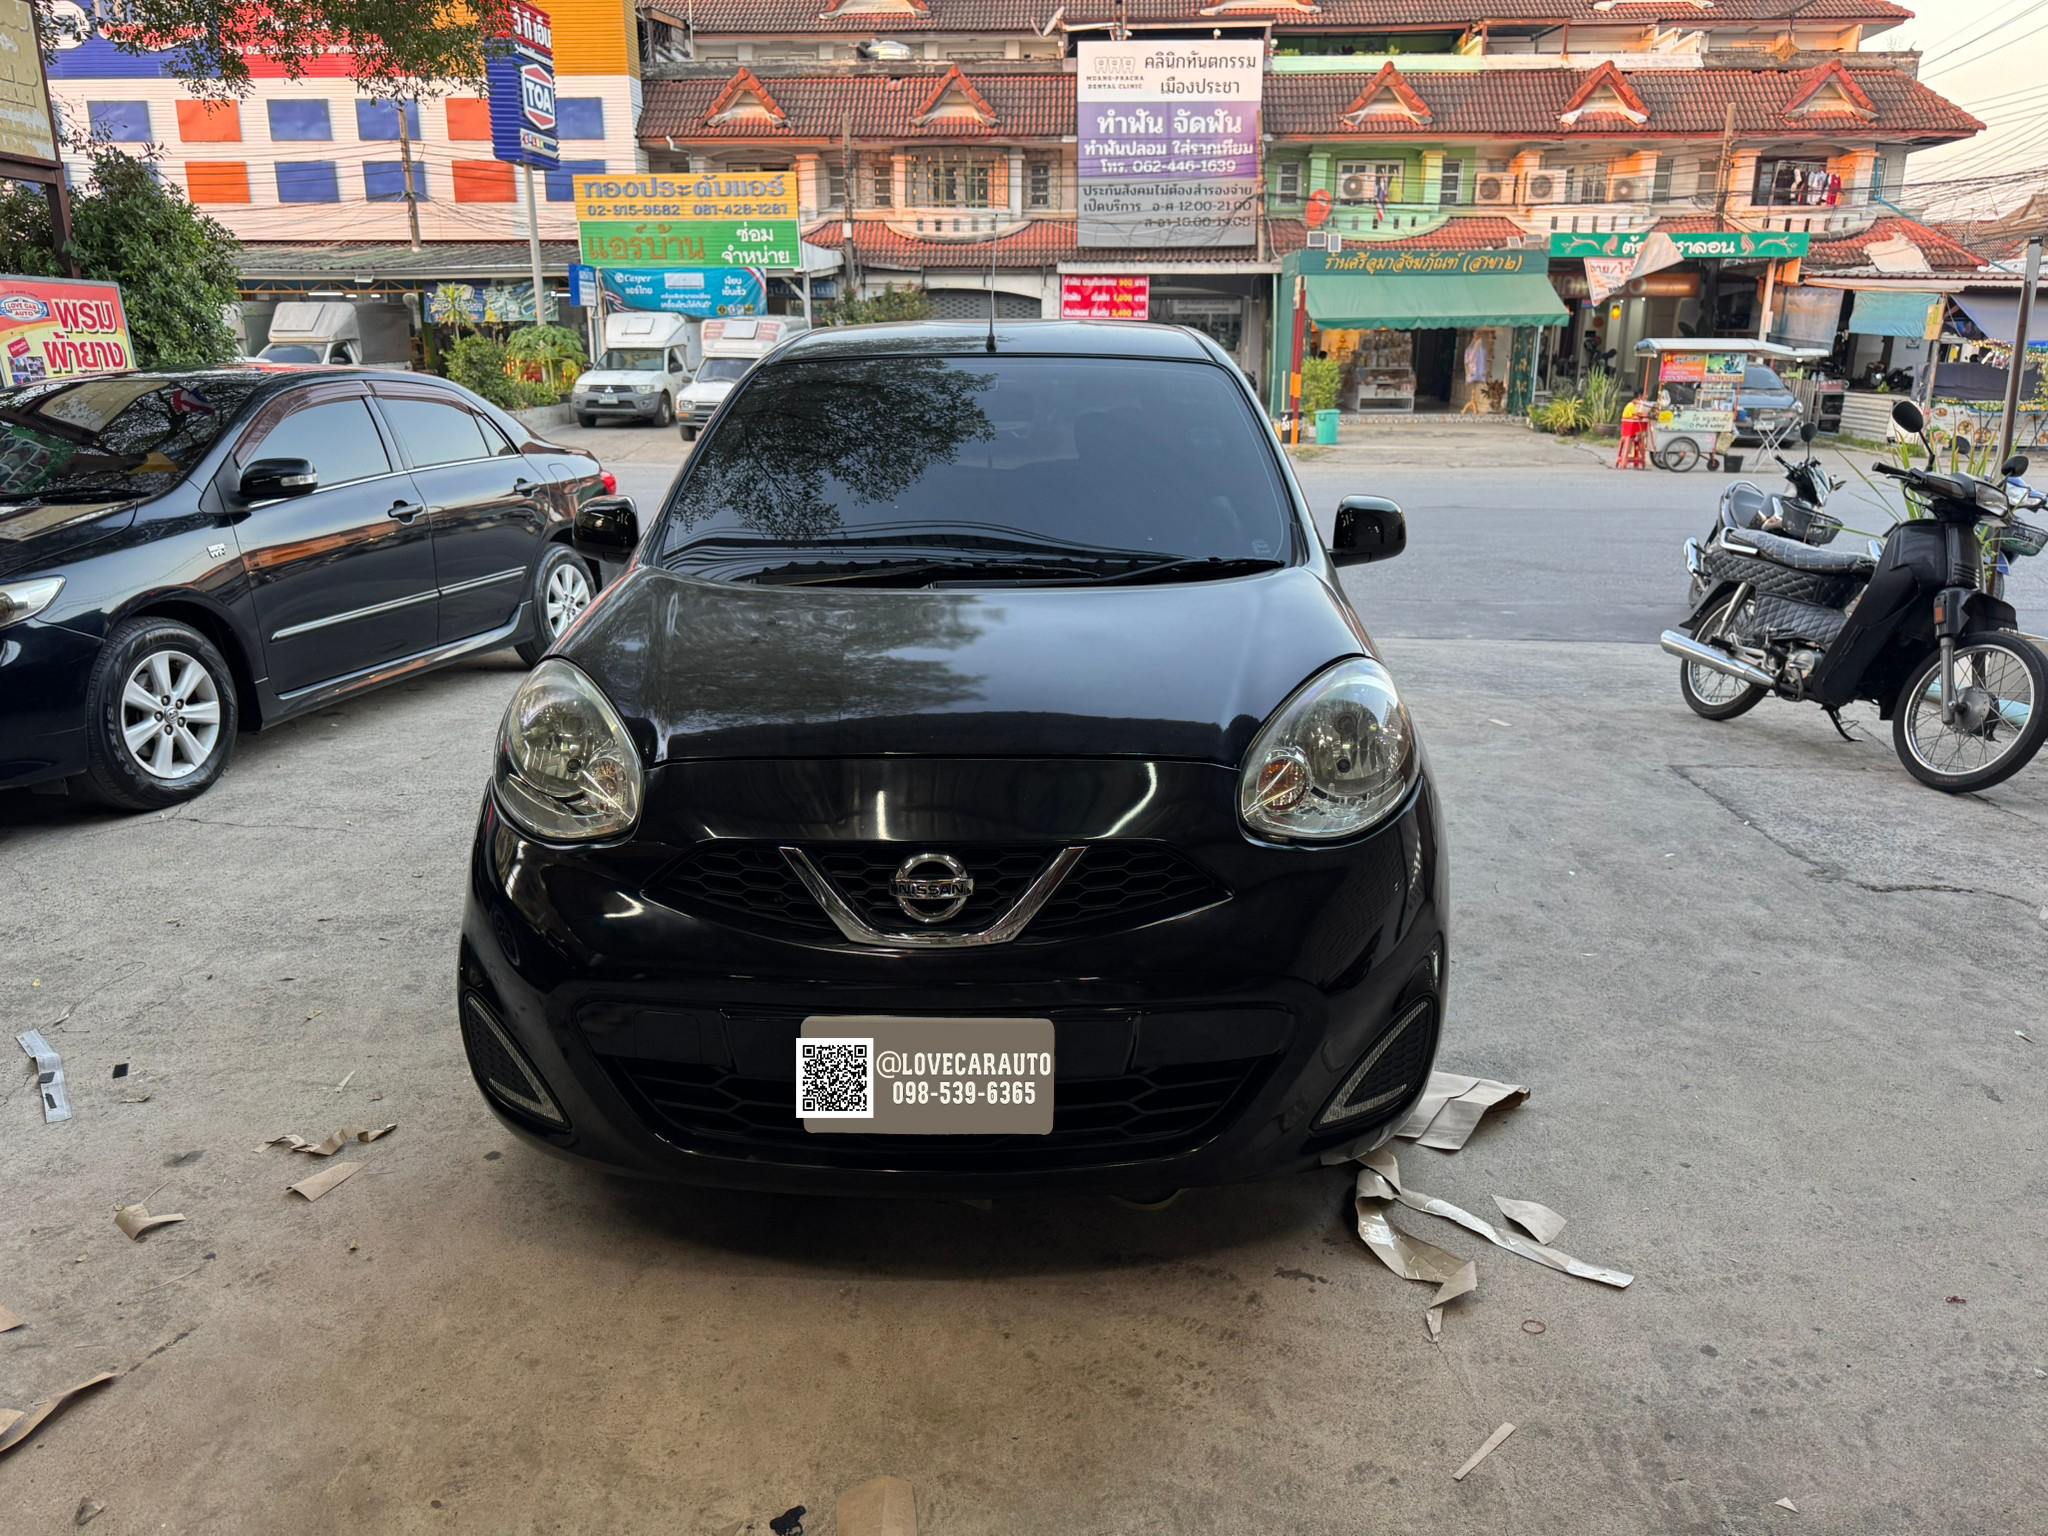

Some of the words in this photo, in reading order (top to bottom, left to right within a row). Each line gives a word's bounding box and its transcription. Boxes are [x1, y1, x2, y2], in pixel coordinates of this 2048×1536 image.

[1145, 51, 1256, 69] คลินิกทันตกรรม
[1161, 77, 1240, 94] เมืองประชา
[525, 79, 552, 113] TOA
[1097, 109, 1163, 134] ทำฟัน
[1173, 108, 1242, 133] จัดฟัน
[1084, 139, 1166, 156] ทำฟันปลอม
[1172, 138, 1253, 155] ใส่รากเทียม
[1133, 160, 1236, 173] 062-446-1639
[584, 175, 785, 198] ทองประดับแอร์
[1083, 184, 1252, 196] ประกันสังคมไม่ต้องสำรองจ่าย
[587, 205, 680, 216] 02-915-9682
[693, 203, 788, 216] 081-428-1281
[1084, 198, 1141, 212] เปิดบริการ
[736, 221, 774, 242] ซ่อม
[587, 223, 705, 260] แอร์บ้าน
[721, 244, 790, 264] จำหน่าย
[52, 299, 116, 332] พรม
[42, 331, 126, 369] ผ้ายาง
[899, 884, 965, 895] NISSAN
